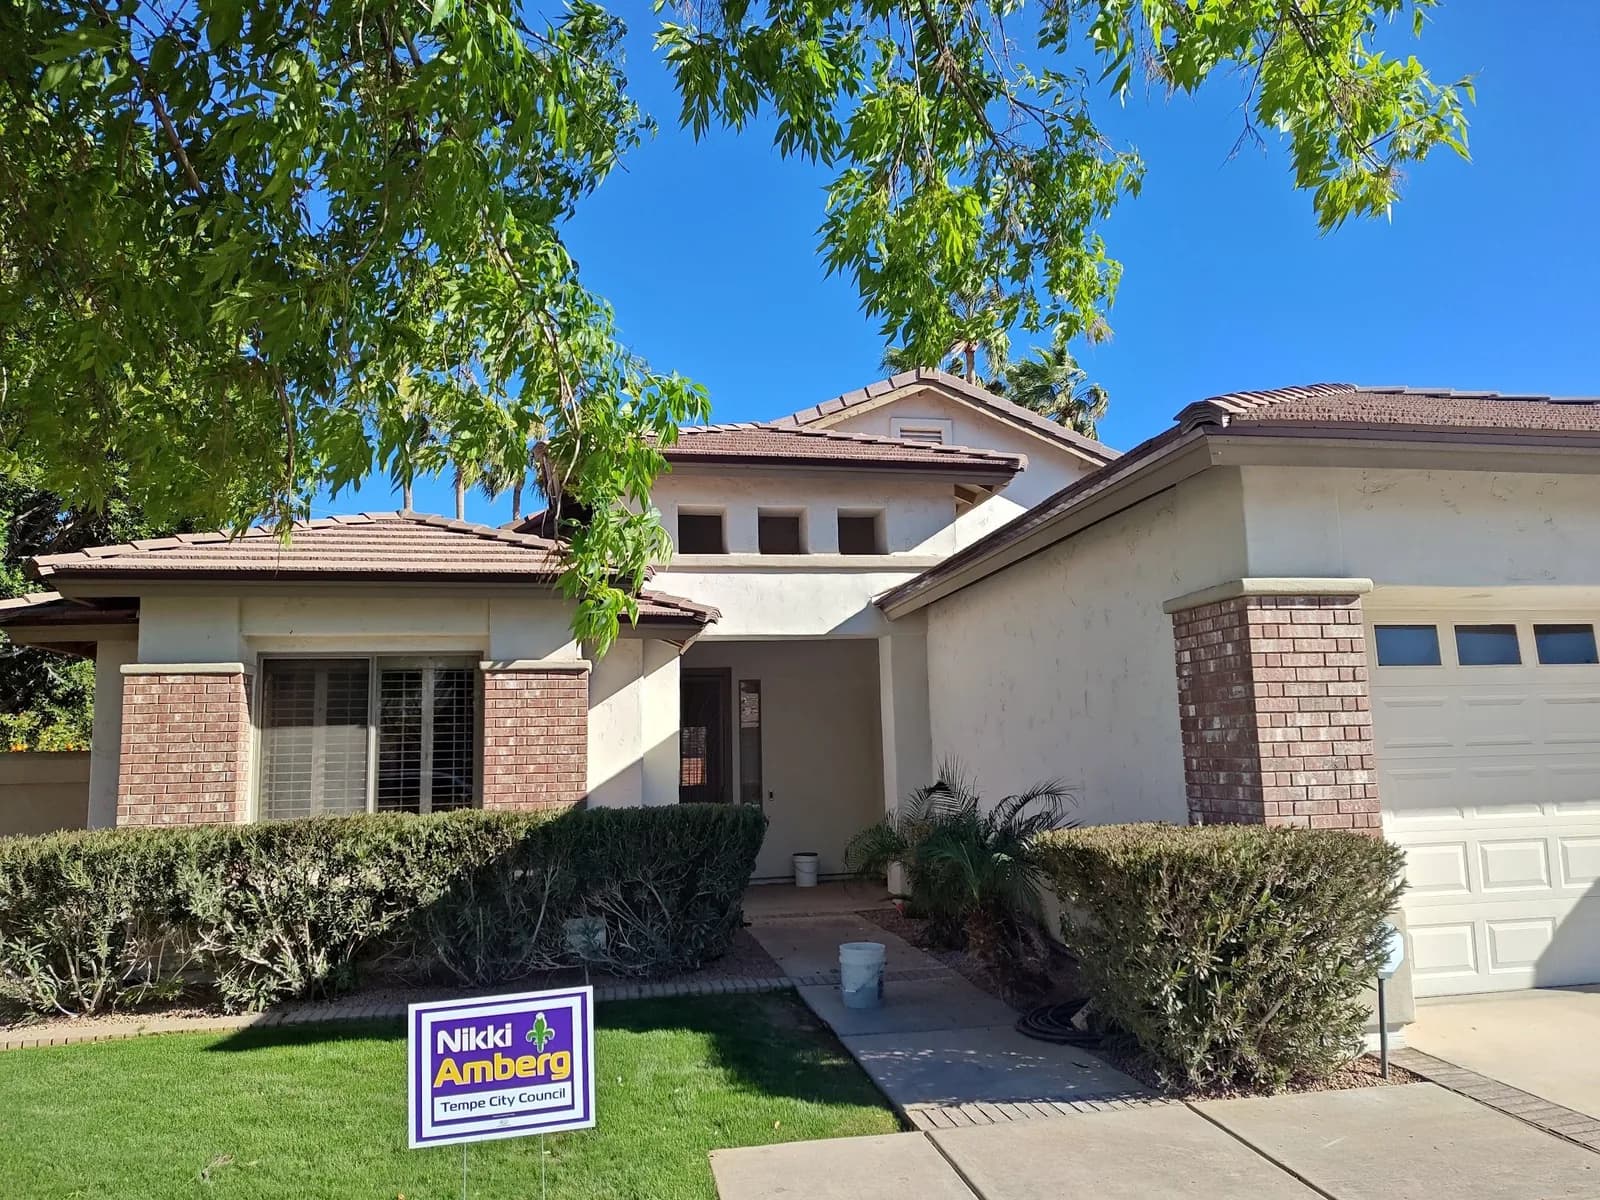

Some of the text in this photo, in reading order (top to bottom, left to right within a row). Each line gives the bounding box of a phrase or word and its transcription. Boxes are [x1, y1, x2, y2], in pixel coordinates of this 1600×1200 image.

[437, 1023, 512, 1054] Nikki
[433, 1050, 571, 1088] Amberg
[441, 1088, 566, 1112] Tempe City Council
